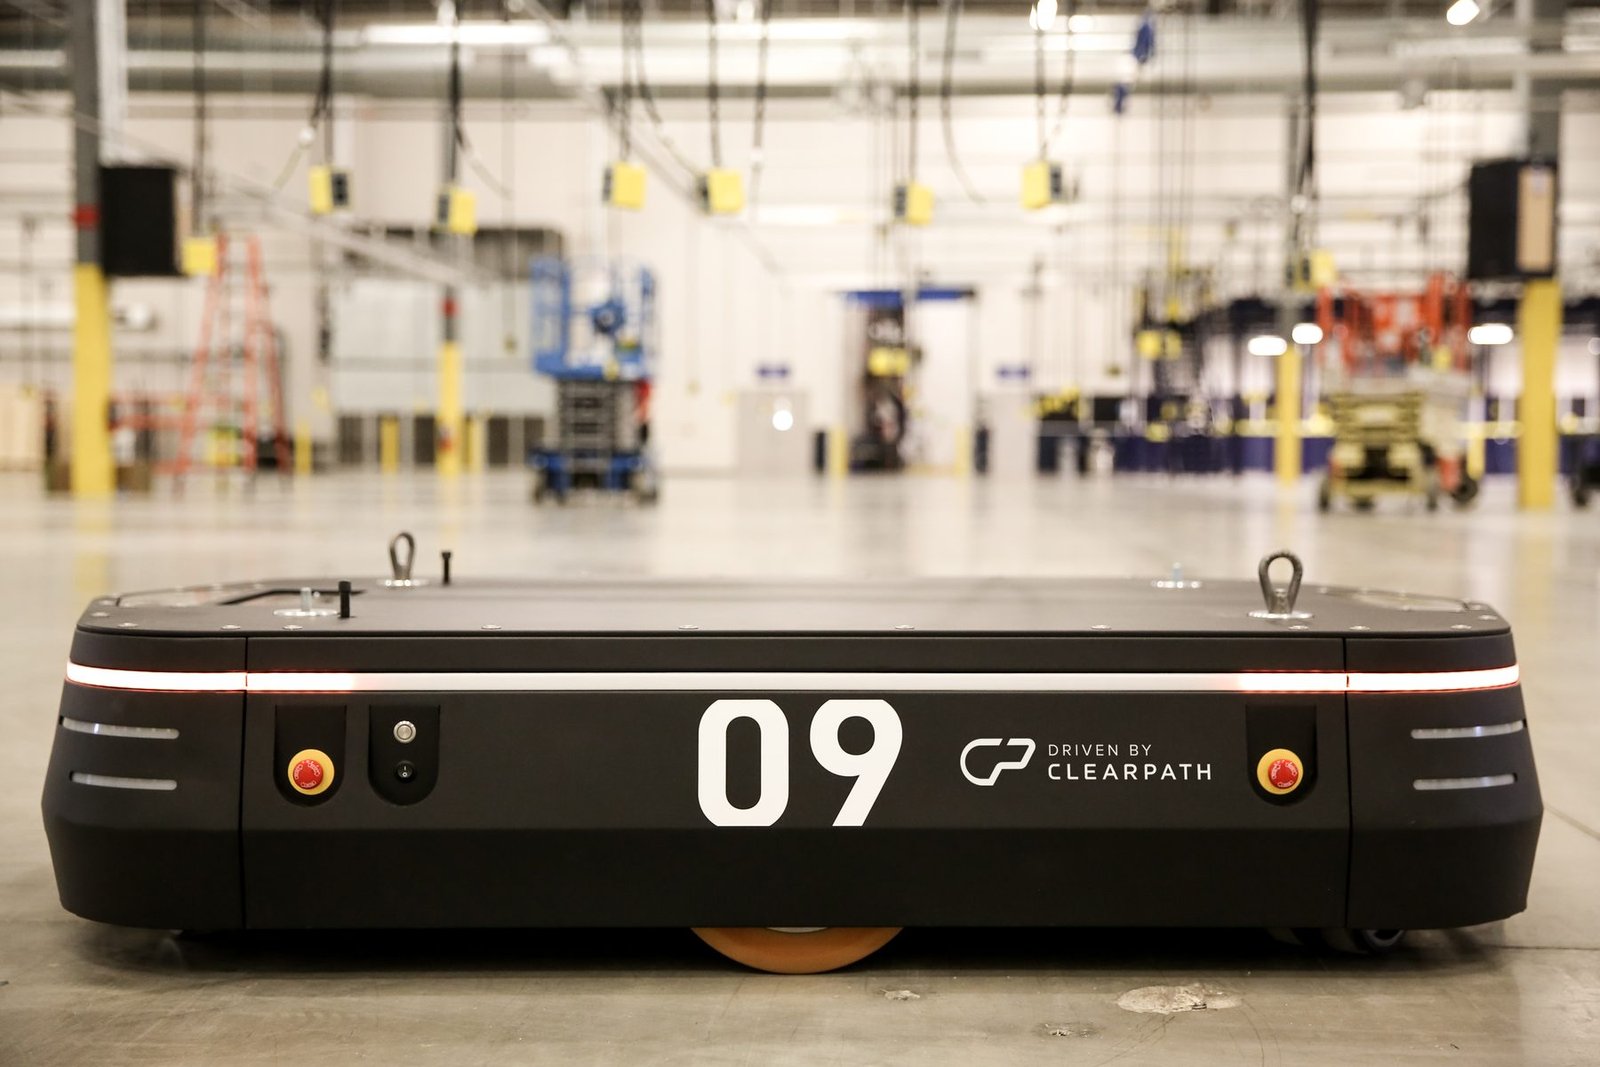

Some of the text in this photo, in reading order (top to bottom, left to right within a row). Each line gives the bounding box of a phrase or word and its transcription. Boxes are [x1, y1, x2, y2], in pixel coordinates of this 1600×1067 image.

[1048, 744, 1152, 757] DRIVEN BY
[698, 699, 903, 827] 09
[1047, 763, 1212, 781] CLEARPATH
